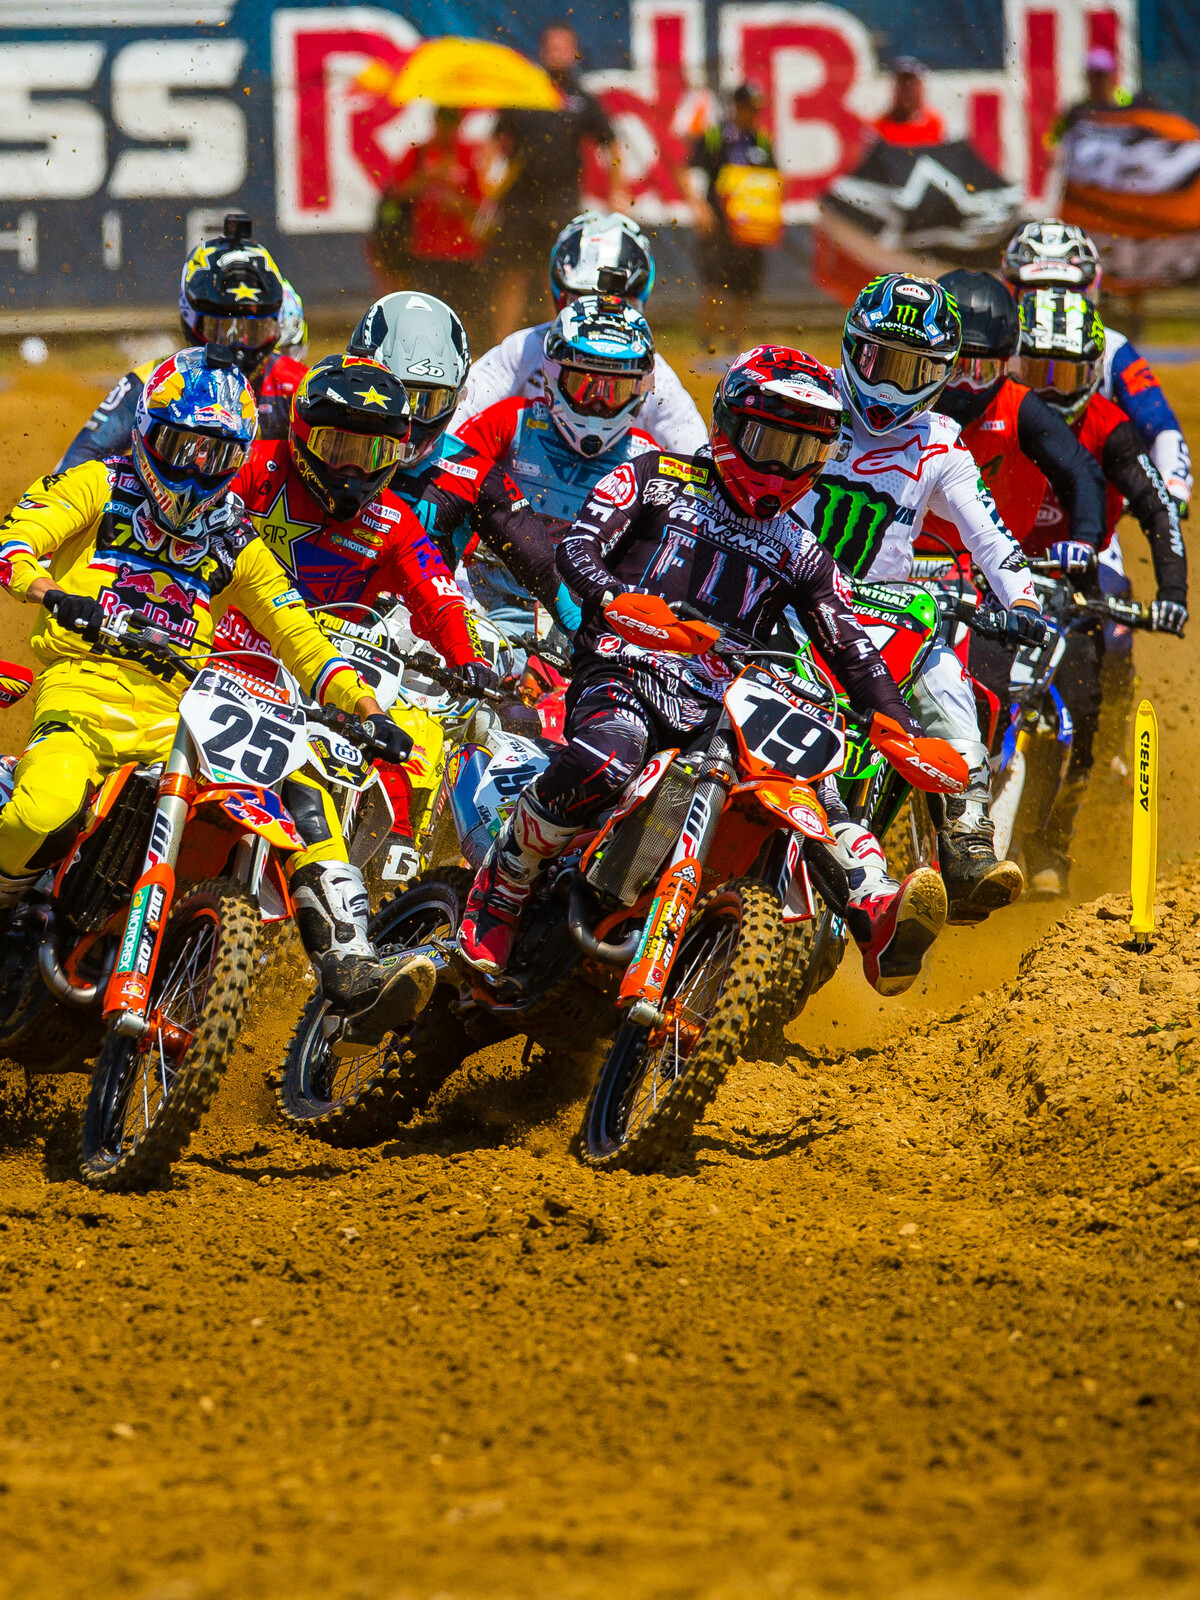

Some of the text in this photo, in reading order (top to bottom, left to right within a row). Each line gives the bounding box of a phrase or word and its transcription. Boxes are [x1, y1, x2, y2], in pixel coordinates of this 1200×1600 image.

[902, 286, 925, 298] BELL
[875, 321, 929, 342] MONSTER
[407, 358, 445, 378] 6D
[460, 466, 477, 477] PRO
[692, 502, 788, 555] ROCKY MOUNTAIN
[342, 540, 379, 560] MOTOREX
[150, 608, 195, 648] Bull
[316, 611, 381, 647] PROTAPER
[606, 610, 670, 640] ACERBIS
[881, 612, 899, 626] OIL
[353, 646, 373, 661] OIL
[217, 668, 286, 703] RENTHAL
[221, 679, 278, 718] LUCA OIL
[770, 680, 801, 708] LUCAS
[802, 701, 821, 719] OIL
[201, 703, 296, 785] 25
[743, 694, 843, 783] 19
[904, 754, 966, 793] ACERBIS
[1139, 730, 1151, 812] ACERBIS
[120, 907, 149, 972] MOTOREX
[137, 888, 165, 975] DUOP
